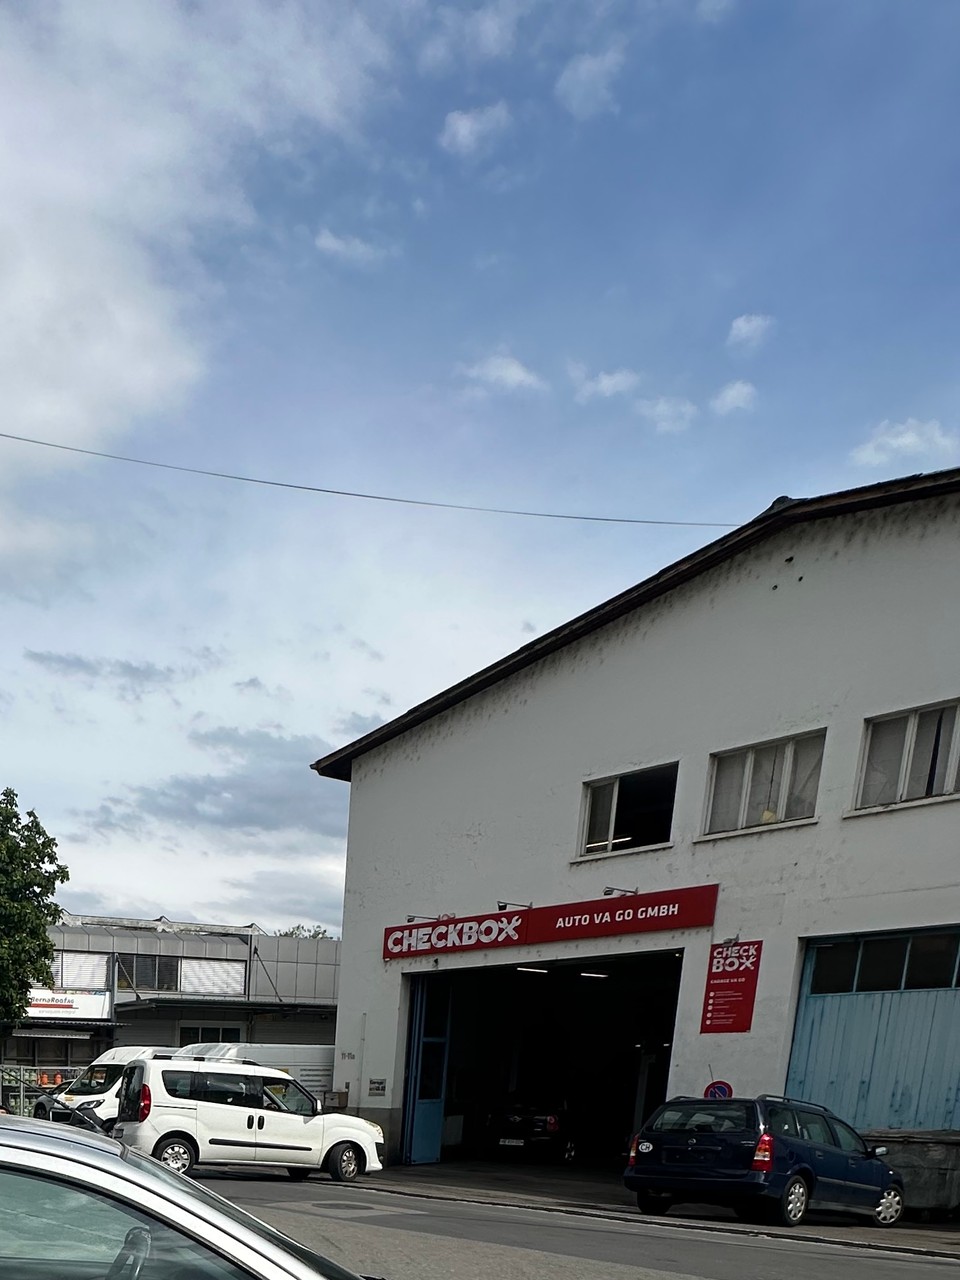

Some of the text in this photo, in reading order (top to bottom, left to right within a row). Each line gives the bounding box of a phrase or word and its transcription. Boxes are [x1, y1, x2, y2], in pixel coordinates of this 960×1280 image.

[555, 903, 679, 929] AUTO VA GO GMBH
[387, 915, 522, 953] CHECKBOX
[714, 945, 758, 957] CHECK
[712, 956, 757, 972] BOX
